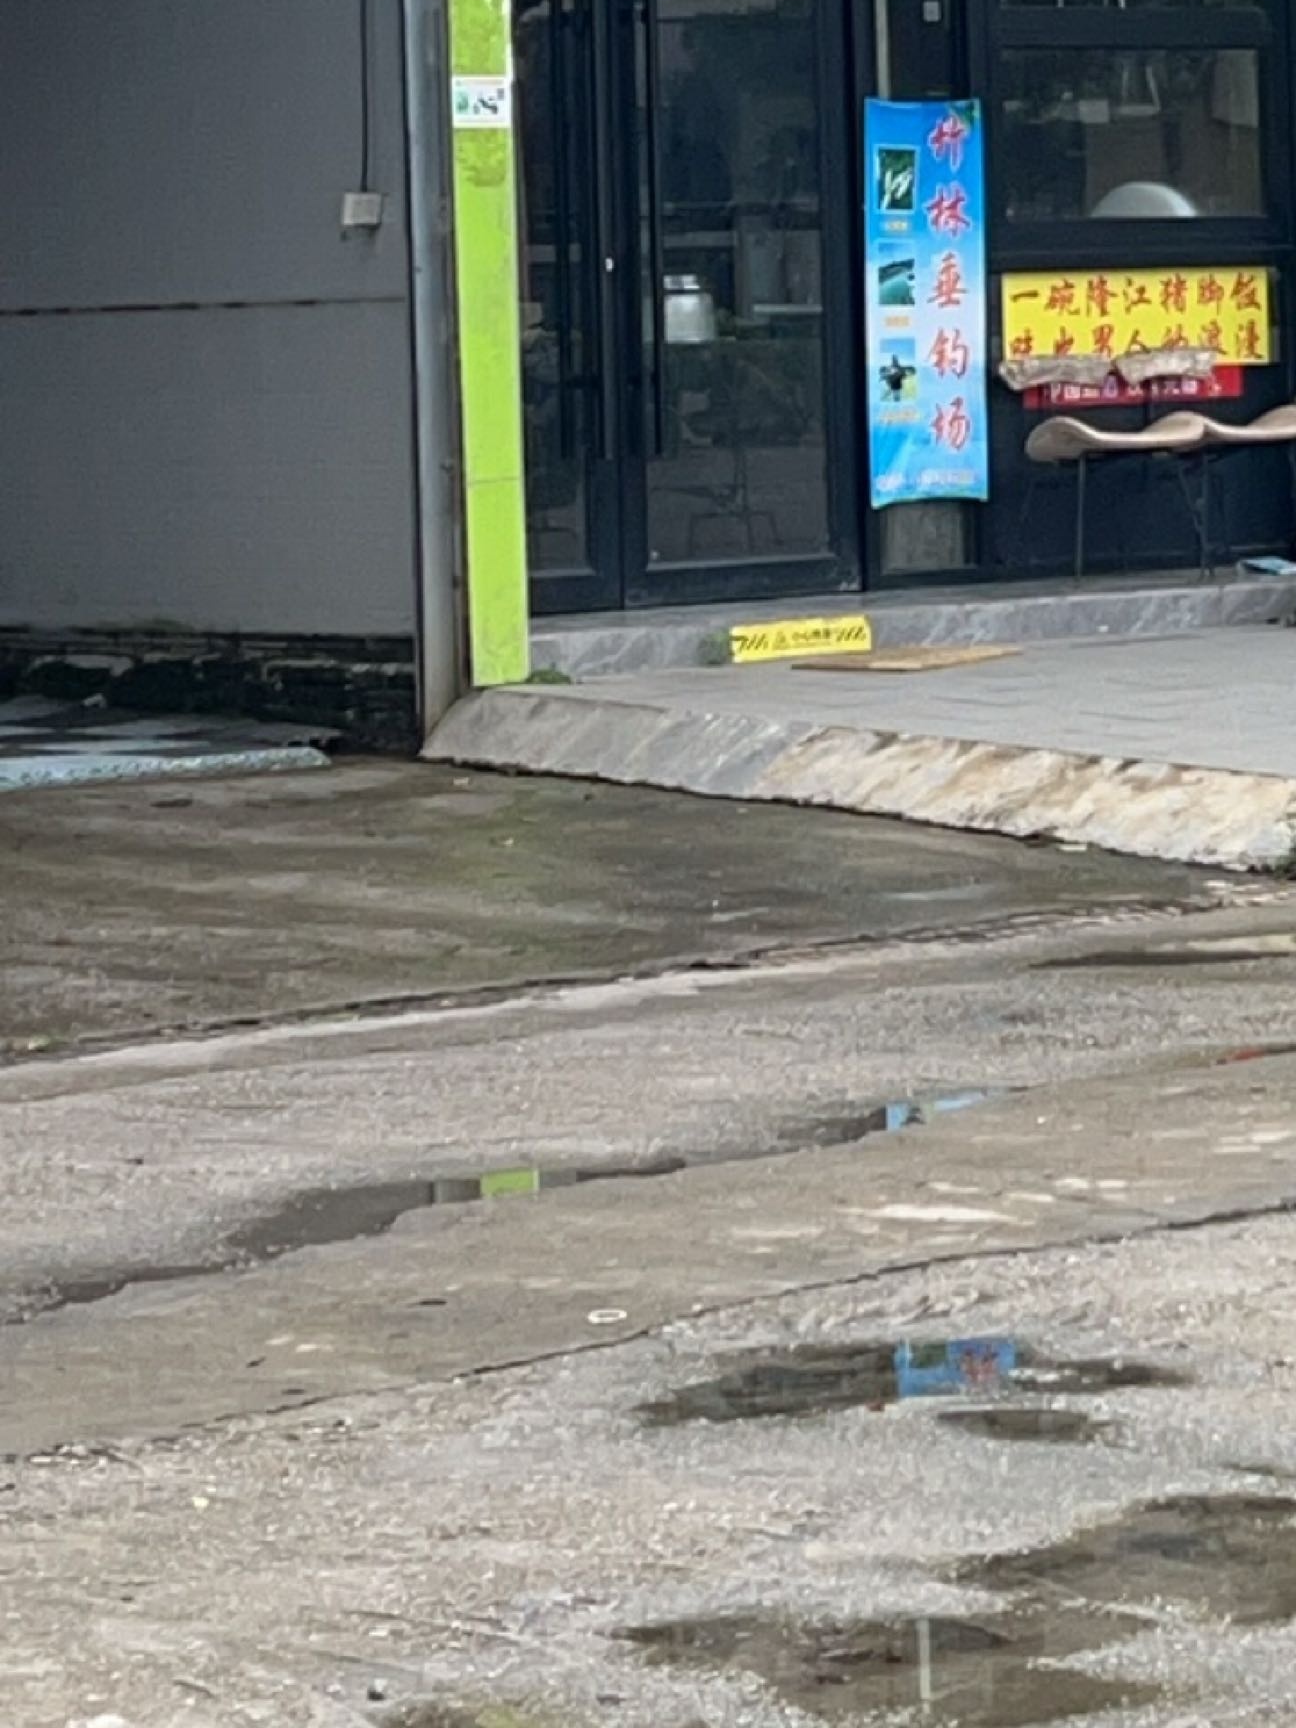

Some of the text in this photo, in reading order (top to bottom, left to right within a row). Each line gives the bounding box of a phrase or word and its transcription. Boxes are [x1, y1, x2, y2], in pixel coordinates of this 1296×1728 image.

[925, 113, 972, 453] 竹林垂钓场
[1009, 273, 1263, 318] 一碗隆江猪脚饭
